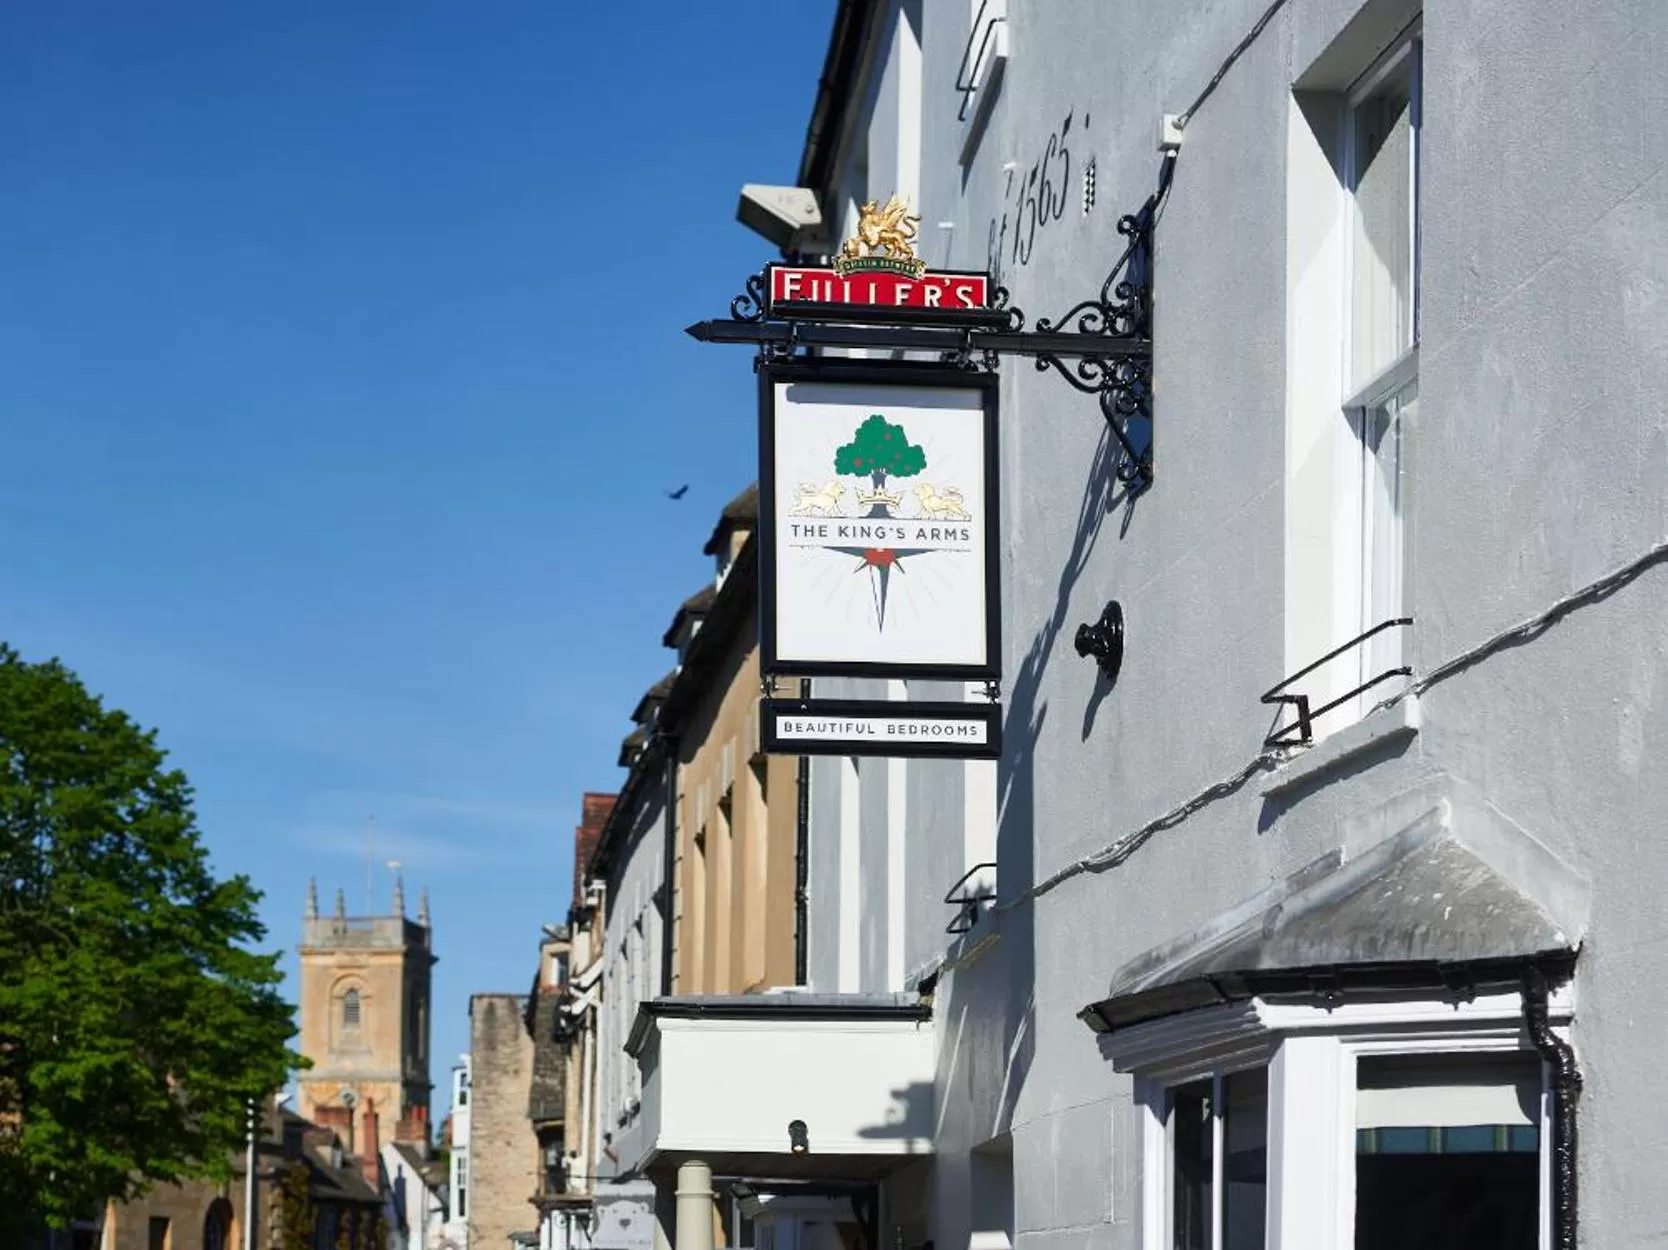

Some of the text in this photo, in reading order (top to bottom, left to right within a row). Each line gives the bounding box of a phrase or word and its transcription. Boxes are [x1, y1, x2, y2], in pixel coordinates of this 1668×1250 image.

[784, 273, 974, 309] FULLER'S
[792, 525, 970, 541] THE KING'S ARMS
[784, 722, 977, 736] BEAUTIFUL BEDROOMS
